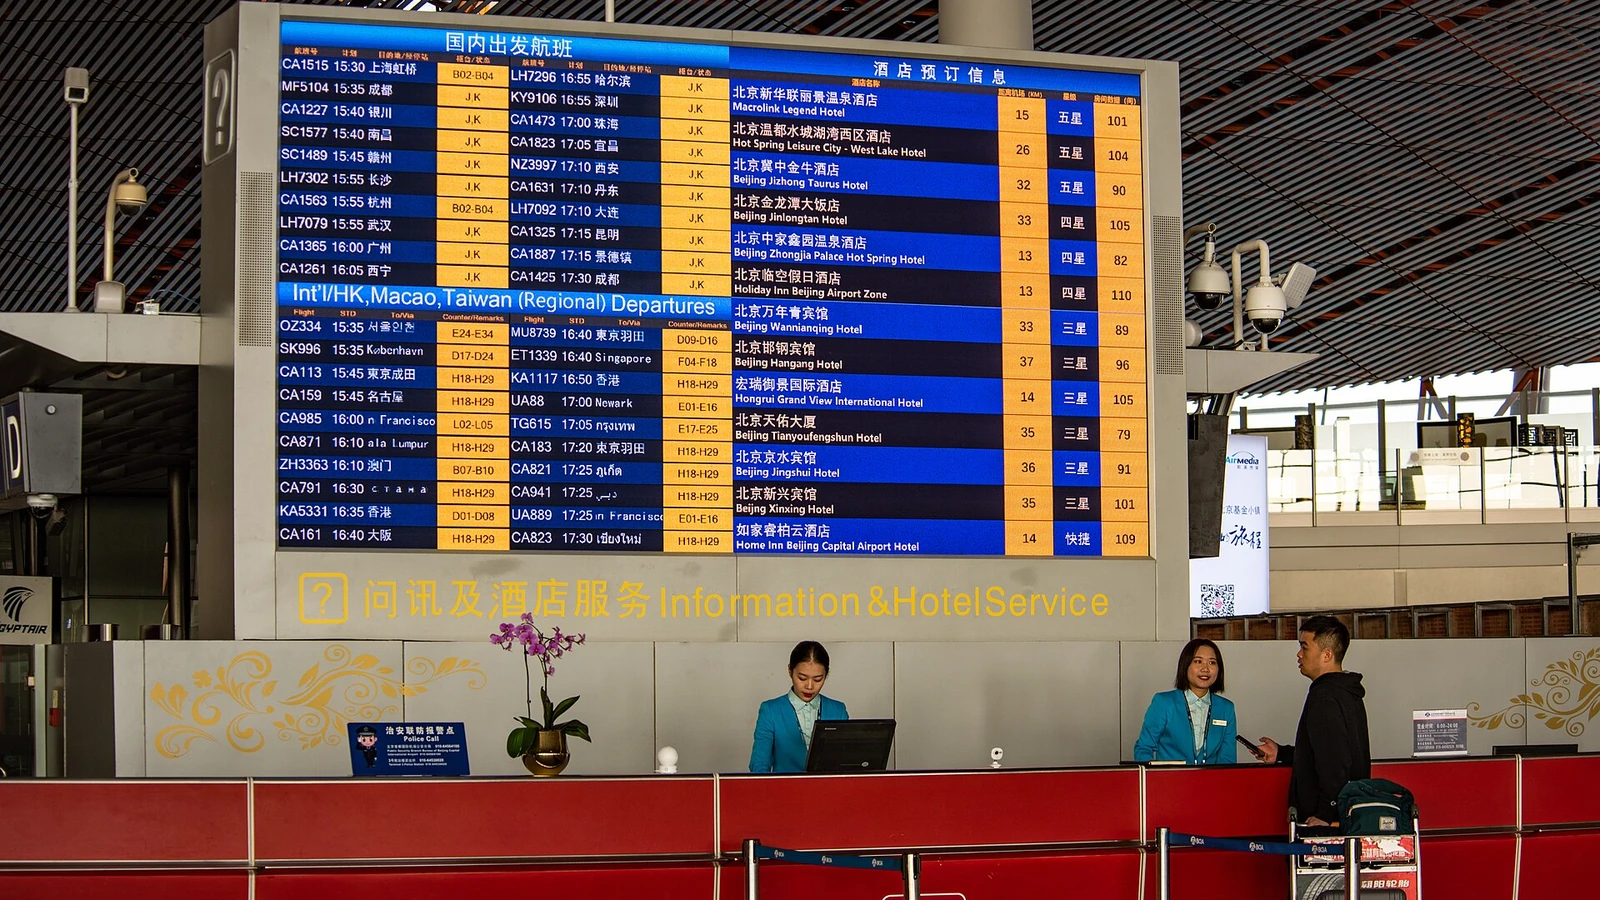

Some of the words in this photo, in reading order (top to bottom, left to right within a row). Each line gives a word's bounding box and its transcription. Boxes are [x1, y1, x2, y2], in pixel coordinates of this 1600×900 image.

[446, 32, 572, 58] 国内出发航班
[282, 58, 329, 71] CA1515
[334, 60, 366, 73] 15:30
[369, 61, 417, 75] 上海虹桥
[453, 70, 494, 81] B02-B04
[511, 91, 557, 104] KY9106
[561, 94, 591, 106] 16:55
[594, 95, 618, 108] 深圳
[688, 104, 703, 113] J,K
[733, 85, 878, 107] 北京新华联丽景温泉酒店
[281, 103, 328, 116] CA1227
[334, 105, 365, 118] 15:40
[368, 106, 392, 119] 银川
[465, 115, 481, 124] J,K
[733, 102, 780, 113] Macrolink
[783, 105, 817, 116] Legend
[819, 107, 845, 117] Hotel
[1016, 109, 1029, 121] 15
[1058, 111, 1083, 125] 五星
[1108, 116, 1127, 127] 101
[510, 136, 556, 149] CA1823
[561, 139, 591, 150] 17:05
[594, 139, 618, 152] 宜昌
[688, 148, 703, 157] J,K
[281, 148, 328, 161] SC1489
[333, 150, 365, 163] 15:45
[367, 151, 392, 164] 赣州
[465, 160, 481, 169] J,K
[510, 181, 554, 193] CA1631
[561, 183, 591, 194] 17:10
[594, 184, 619, 197] 丹东
[689, 192, 704, 201] J,K
[280, 193, 327, 206] CA1563
[332, 196, 364, 208] 15:55
[367, 196, 391, 209] 杭州
[452, 203, 493, 214] B02-B04
[510, 225, 556, 238] CA1325
[561, 227, 592, 239] 17:15
[595, 228, 619, 241] 昆明
[689, 236, 704, 245] J,K
[734, 230, 867, 250] 北京中家鑫园温泉酒店
[280, 239, 327, 252] CA1365
[332, 241, 364, 253] 16:00
[367, 241, 391, 254] 广州
[465, 250, 481, 259] J,K
[734, 247, 767, 260] Beijing
[769, 249, 812, 262] Zhongjia
[814, 251, 844, 261] Palace
[846, 253, 864, 262] Hot
[867, 253, 897, 266] Spring
[900, 255, 925, 265] Hotel
[1018, 250, 1032, 261] 13
[1061, 252, 1086, 265] 四星
[1114, 255, 1127, 266] 82
[510, 270, 556, 282] CA1425
[561, 272, 592, 284] 17:30
[595, 273, 620, 286] 成都
[689, 280, 704, 290] J,K
[519, 292, 605, 312] (Regional)
[612, 295, 715, 316] Departures
[442, 313, 504, 322] Counter/Remarks
[524, 316, 544, 324] Flight
[280, 319, 322, 332] OZ334
[332, 321, 364, 333] 15:35
[452, 329, 493, 338] E24-E34
[511, 327, 556, 338] MU8739
[562, 328, 592, 340] 16:40
[596, 329, 644, 342] 東京羽田
[677, 335, 718, 346] D09-D16
[280, 342, 321, 355] SK996
[333, 344, 364, 356] 15:35
[452, 351, 494, 361] D17-D24
[511, 349, 557, 361] ET1339
[562, 351, 592, 362] 16:40
[595, 352, 652, 365] Singapore
[678, 357, 717, 367] F04-F18
[735, 376, 842, 394] 宏瑞御景国际酒店
[280, 388, 322, 401] CA159
[332, 390, 364, 402] 15:45
[367, 390, 403, 403] 名古屋
[452, 397, 494, 407] H18-H29
[511, 394, 545, 407] UA88
[562, 396, 592, 407] 17:00
[595, 397, 633, 408] Newark
[678, 402, 718, 412] E01-E16
[735, 393, 775, 406] Hongrui
[777, 394, 806, 405] Grand
[808, 395, 833, 405] View
[835, 396, 895, 407] International
[898, 398, 923, 408] Hotel
[1021, 392, 1035, 402] 14
[1063, 392, 1088, 405] 三星
[1113, 394, 1134, 405] 105
[510, 417, 552, 430] TG615
[562, 419, 593, 430] 17:05
[678, 424, 718, 434] E17-E25
[7, 416, 21, 479] D
[280, 435, 320, 448] CA871
[332, 437, 364, 448] 16:10
[452, 443, 494, 453] H18-H29
[736, 486, 817, 502] 北京新兴宾馆
[1022, 497, 1036, 509] 35
[1065, 497, 1090, 510] 三星
[1115, 499, 1135, 510] 101
[769, 503, 806, 516] Xinxing
[808, 504, 834, 514] Hotel
[280, 528, 320, 540] CA161
[333, 529, 364, 541] 16:40
[368, 528, 392, 541] 大阪
[452, 534, 495, 544] H18-H29
[511, 531, 553, 544] CA823
[562, 532, 593, 544] 17:30
[678, 537, 720, 546] H18-H29
[364, 578, 650, 619] 问讯及酒店服务
[660, 586, 858, 618] Information
[0, 624, 48, 634] GYPTAIR
